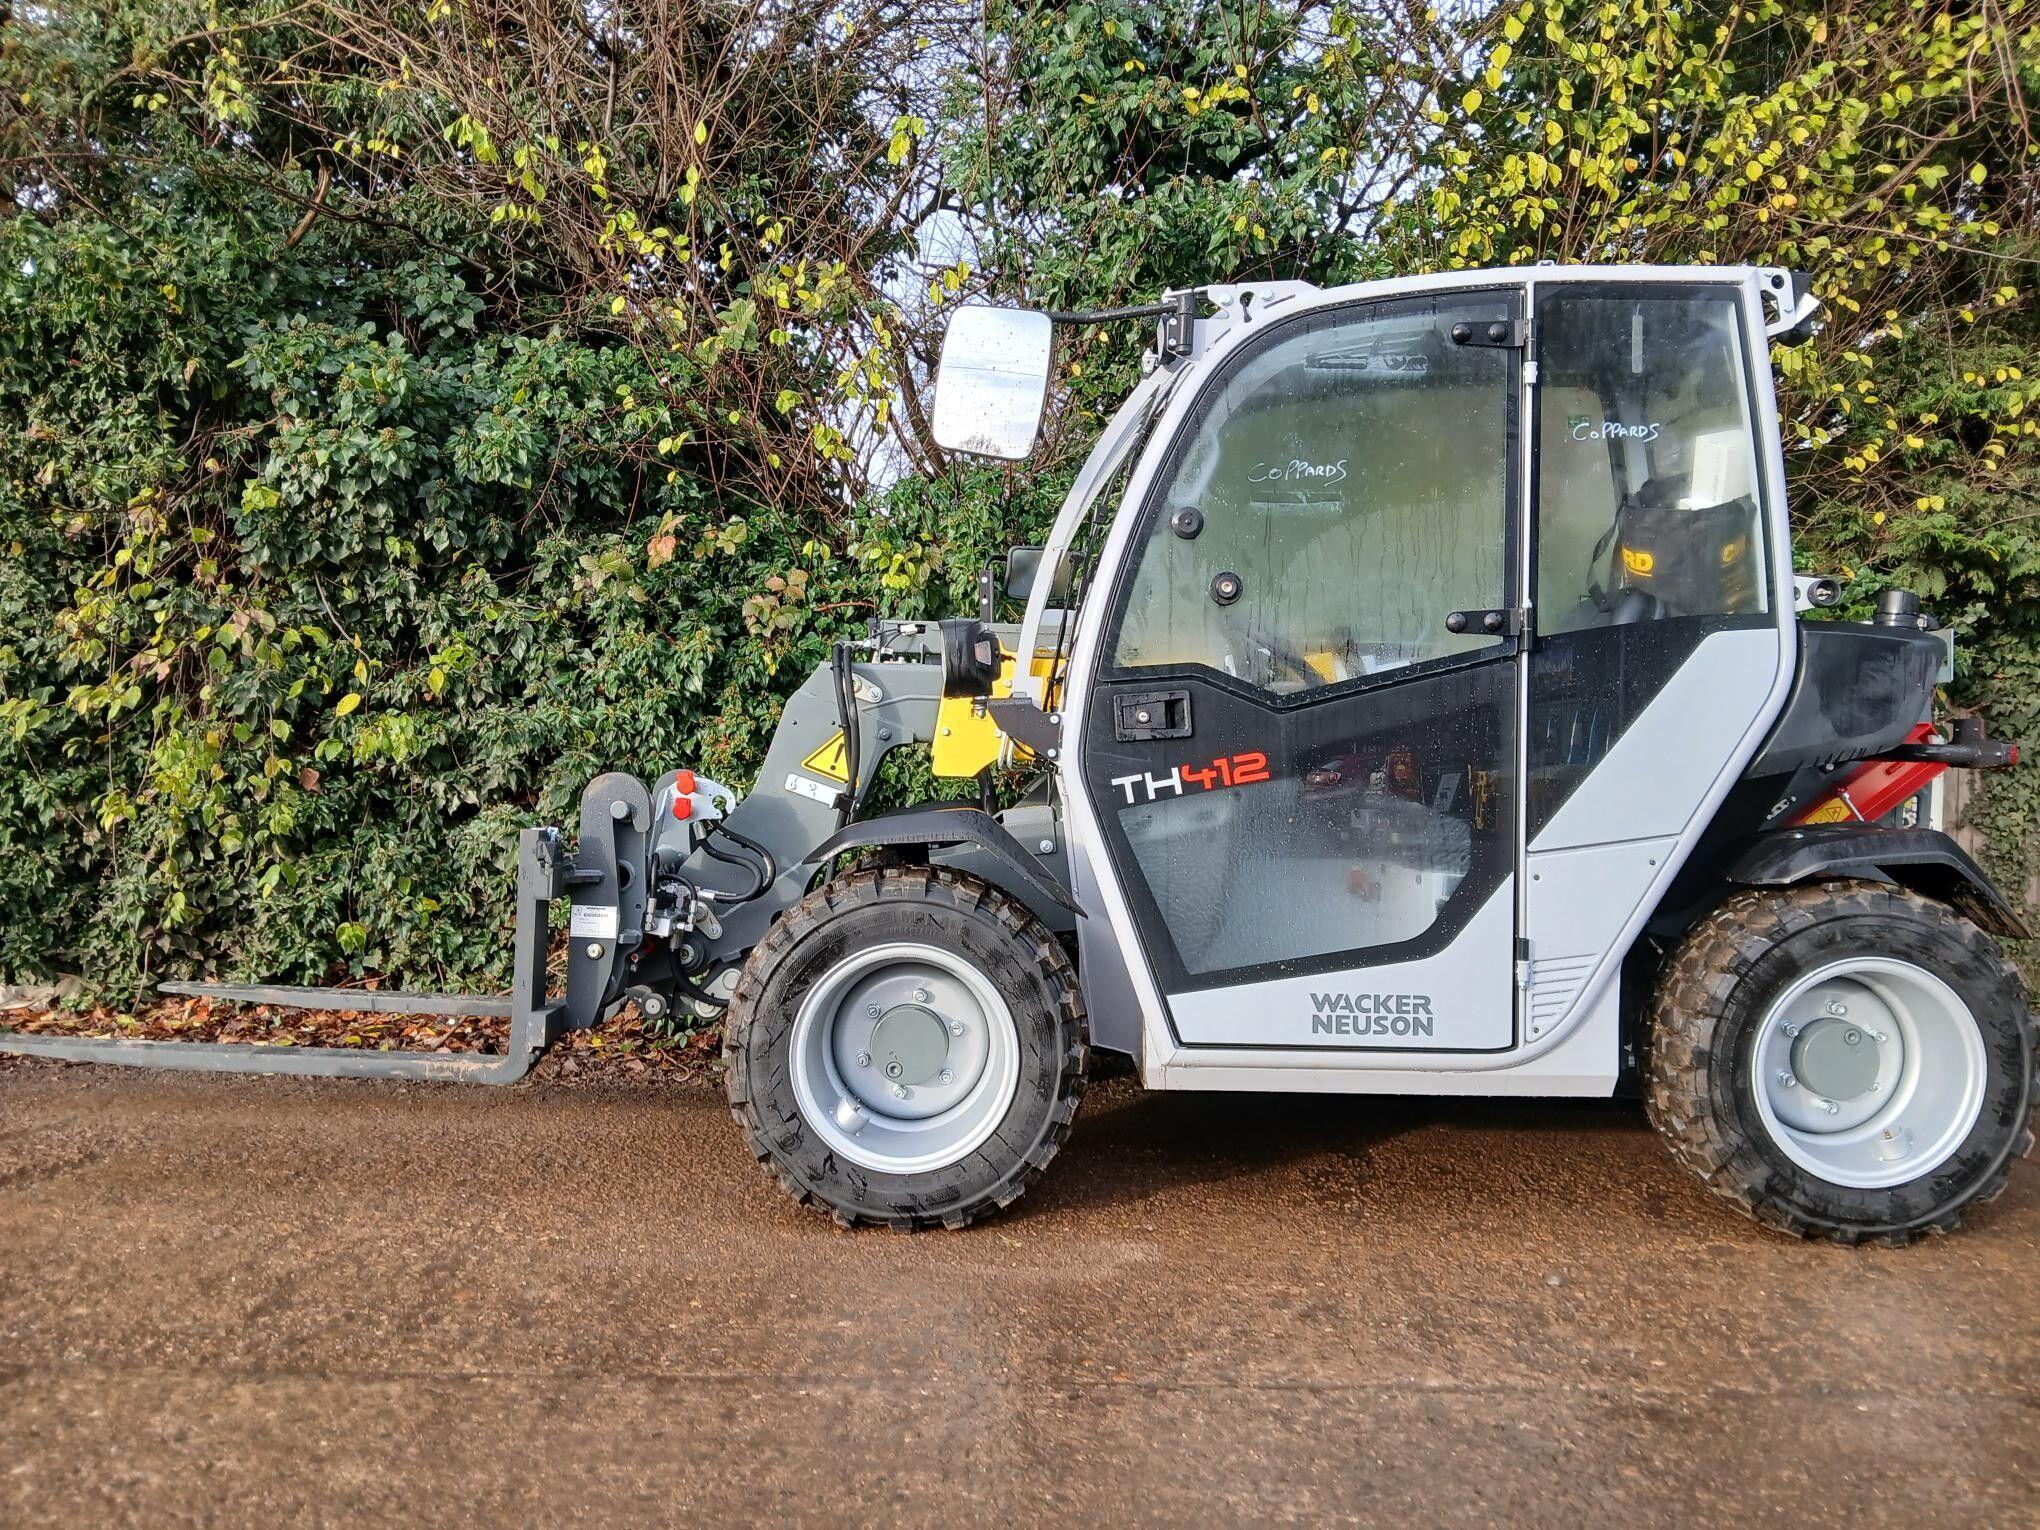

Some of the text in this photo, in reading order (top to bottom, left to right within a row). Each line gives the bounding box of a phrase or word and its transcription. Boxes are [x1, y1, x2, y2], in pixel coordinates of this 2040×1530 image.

[1111, 752, 1270, 804] TH412
[1309, 992, 1433, 1015] WACKER
[1312, 1014, 1433, 1036] NEUSON
